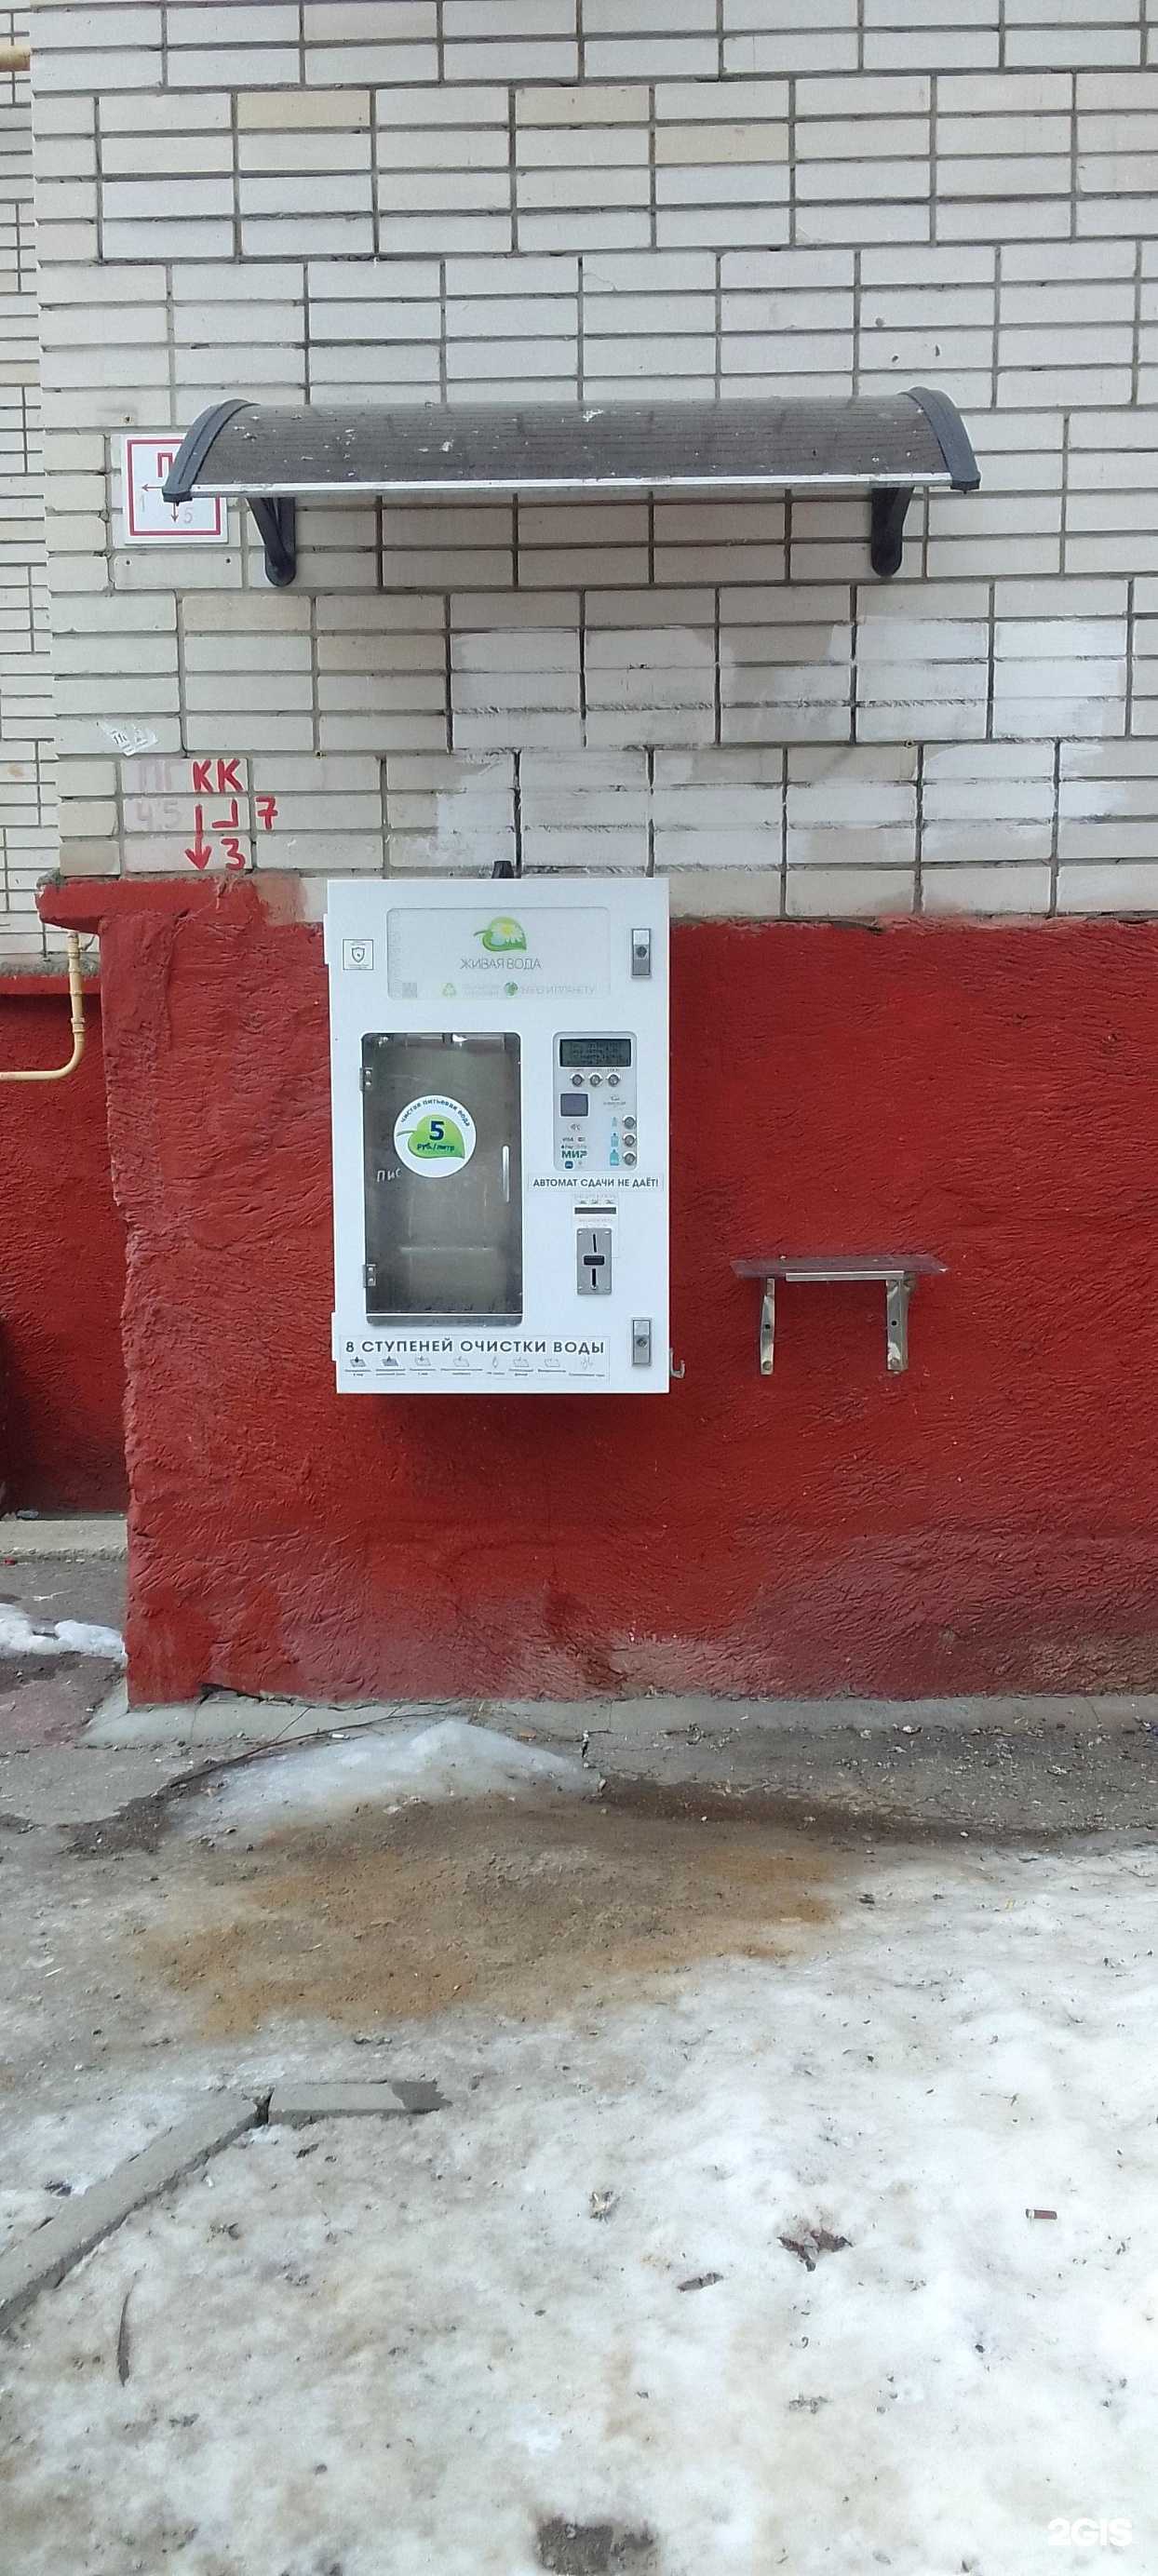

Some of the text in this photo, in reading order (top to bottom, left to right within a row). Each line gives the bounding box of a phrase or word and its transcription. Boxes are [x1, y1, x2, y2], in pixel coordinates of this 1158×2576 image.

[255, 796, 278, 830] 7
[221, 838, 246, 870] 3
[460, 958, 542, 970] ЖИВАЯ ВОДА
[429, 1120, 445, 1141] 5
[561, 1150, 587, 1159] МИР
[581, 1179, 614, 1188] СДАЧИ
[633, 1177, 659, 1188] ДАЁТ!
[345, 1338, 604, 1355] 8 СТУПЕНЕЙ ОЧИСТКИ ВОДЫ
